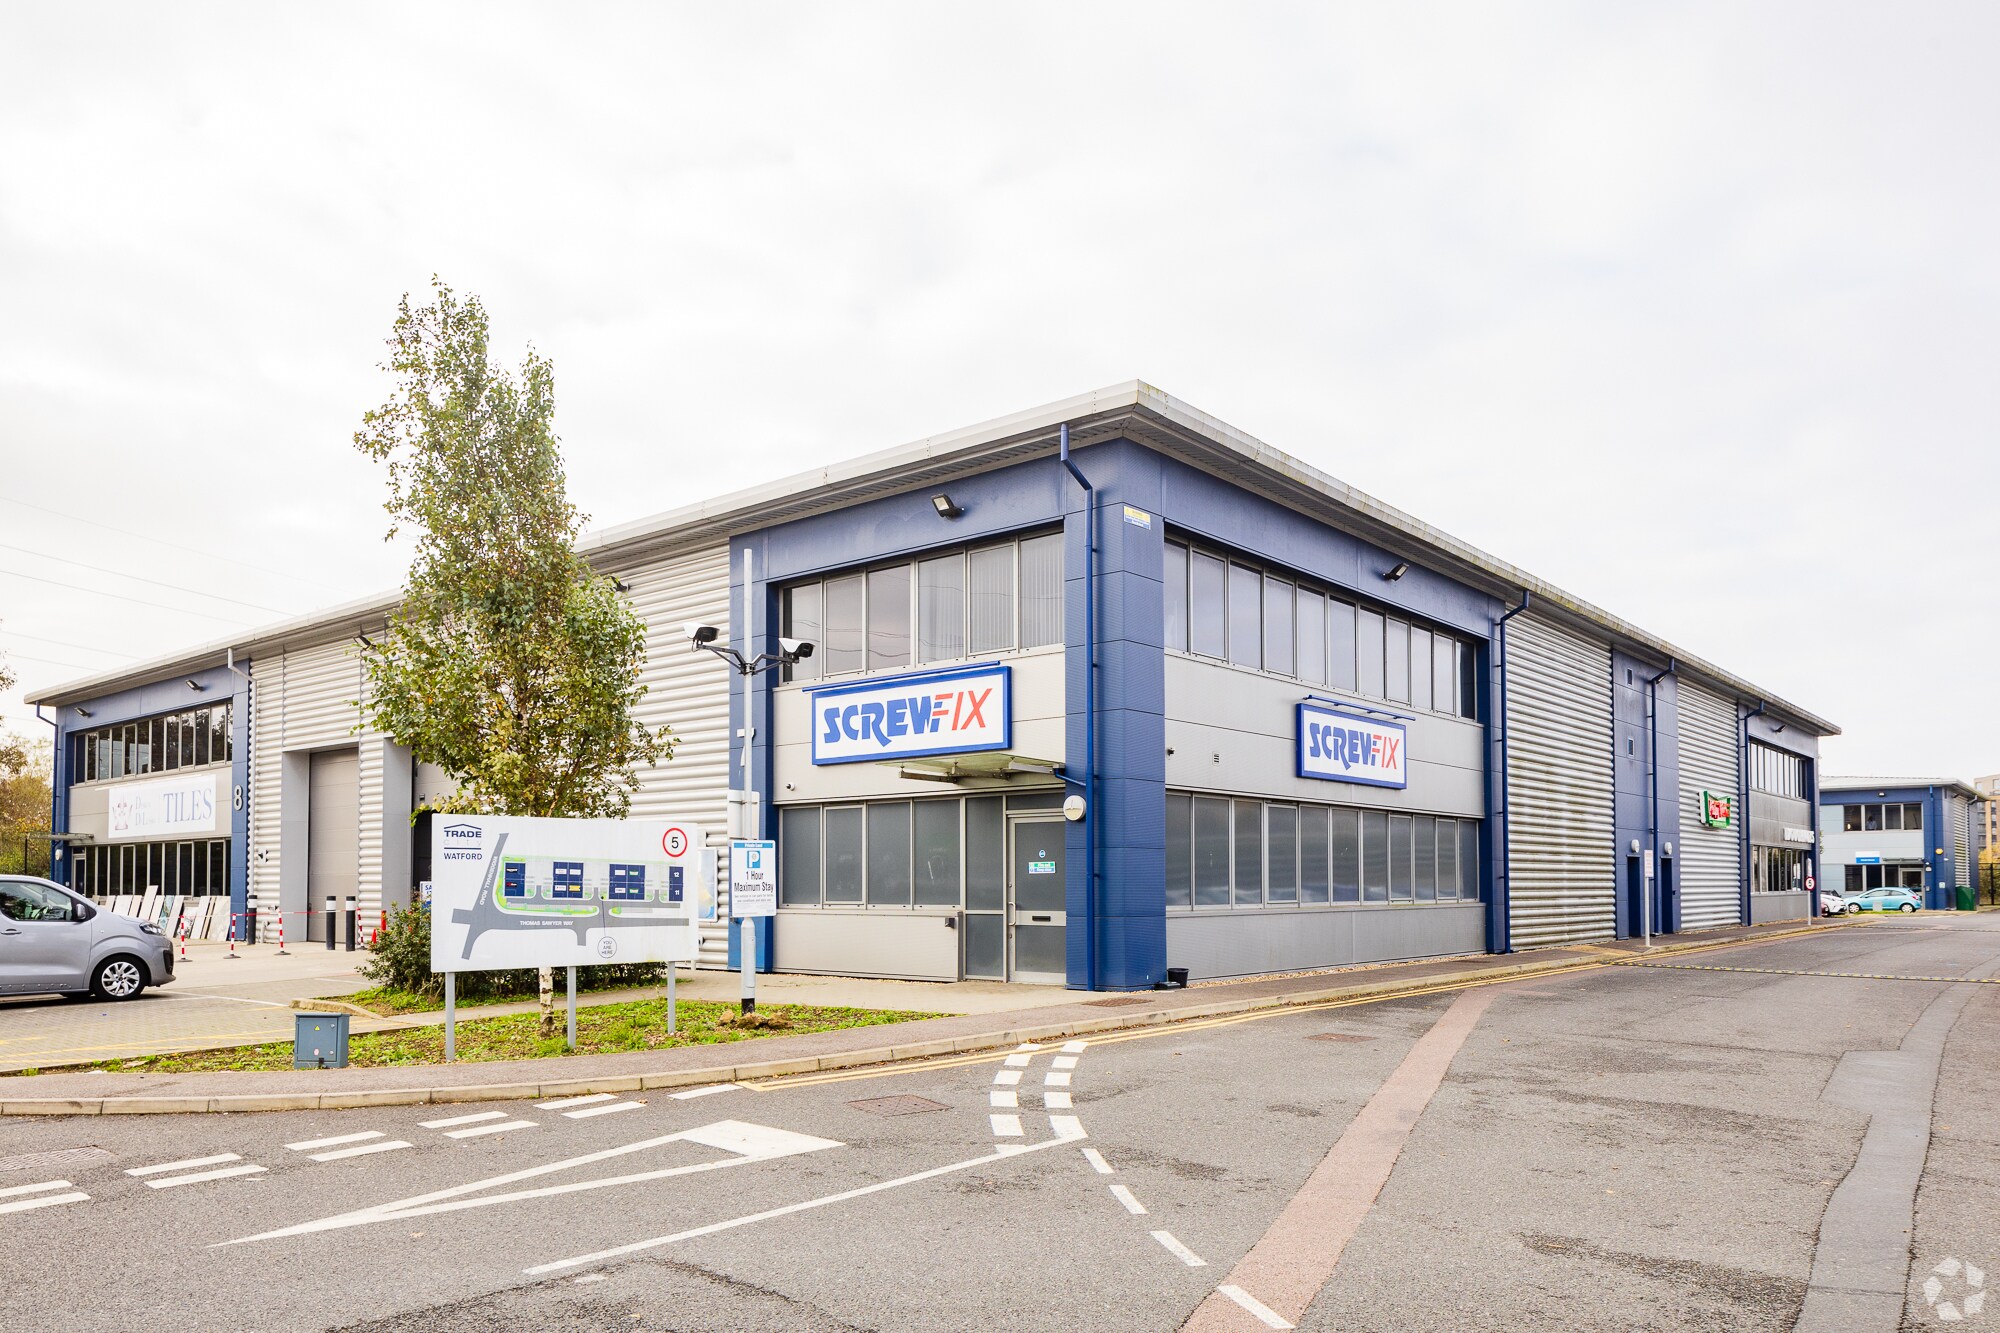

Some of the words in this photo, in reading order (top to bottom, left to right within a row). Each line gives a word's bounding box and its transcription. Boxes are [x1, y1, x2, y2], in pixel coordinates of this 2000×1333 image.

[823, 687, 993, 747] SCREWFIX
[1309, 722, 1400, 771] SCREWFIX
[234, 784, 244, 811] 8
[163, 788, 212, 823] TILES
[443, 830, 482, 838] TRADE
[671, 836, 679, 849] 5
[443, 852, 483, 860] WATFORD
[745, 871, 749, 880] 1
[750, 870, 764, 880] Hour
[734, 882, 760, 892] Maximum
[761, 881, 774, 893] Stay
[480, 889, 488, 906] ROAD
